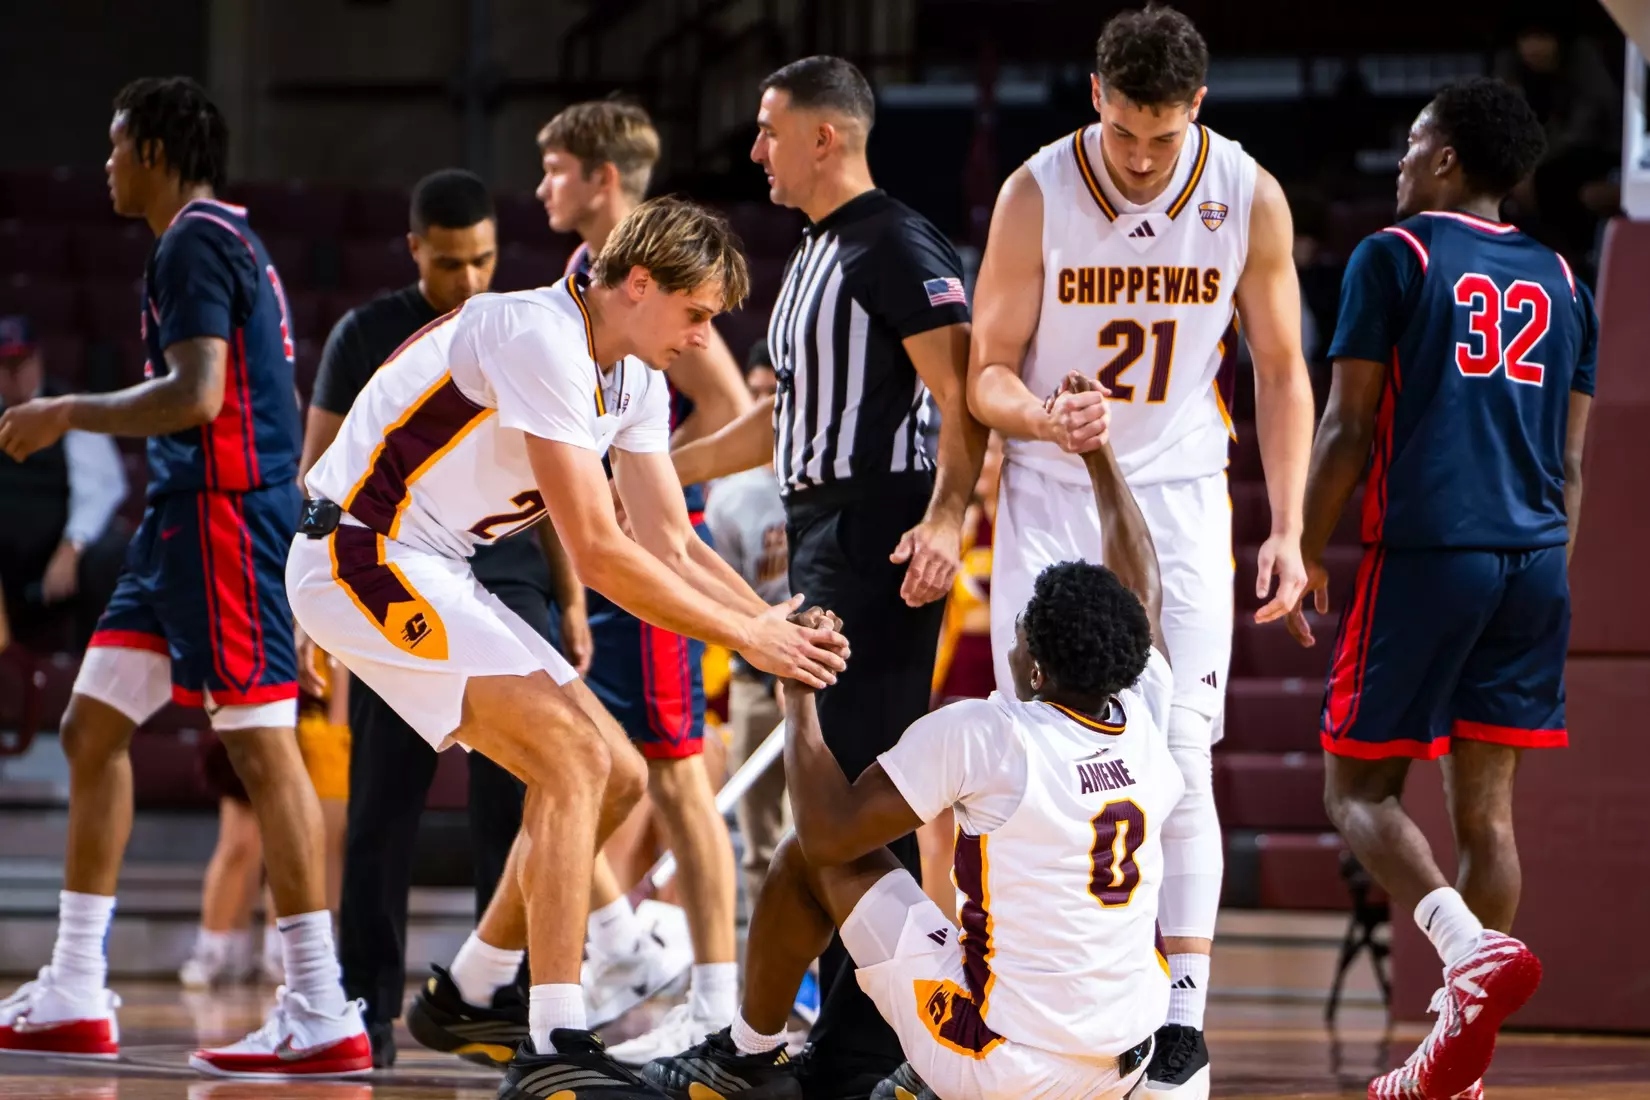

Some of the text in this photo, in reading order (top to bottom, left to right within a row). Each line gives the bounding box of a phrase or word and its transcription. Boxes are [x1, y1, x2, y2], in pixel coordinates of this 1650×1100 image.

[1058, 266, 1221, 305] CHIPPEWAS
[1097, 318, 1178, 404] 21
[1453, 272, 1551, 387] 32
[1076, 758, 1136, 795] AMENE
[1087, 797, 1147, 909] 0
